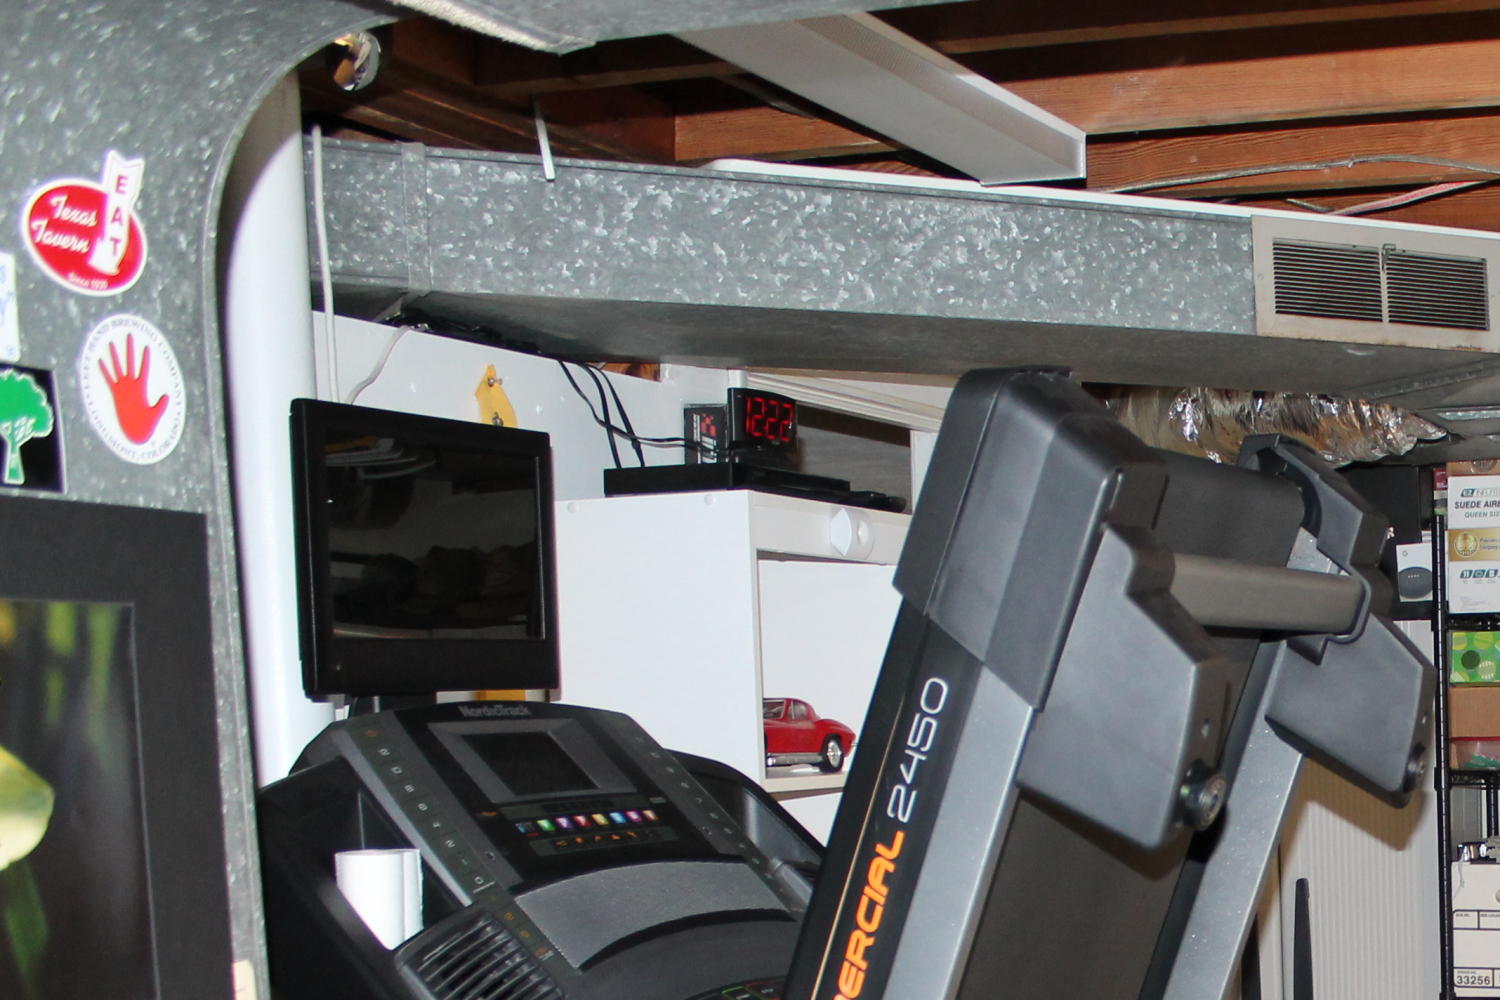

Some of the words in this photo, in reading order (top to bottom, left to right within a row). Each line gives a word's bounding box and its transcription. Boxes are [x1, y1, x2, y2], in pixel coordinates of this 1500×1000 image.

[50, 194, 98, 227] Texas
[110, 175, 128, 257] EAT
[32, 218, 90, 254] Tavern
[1454, 501, 1481, 509] SUEDE
[1464, 511, 1488, 519] QUEEN
[887, 676, 949, 823] 2450
[1456, 975, 1491, 986] 33256
